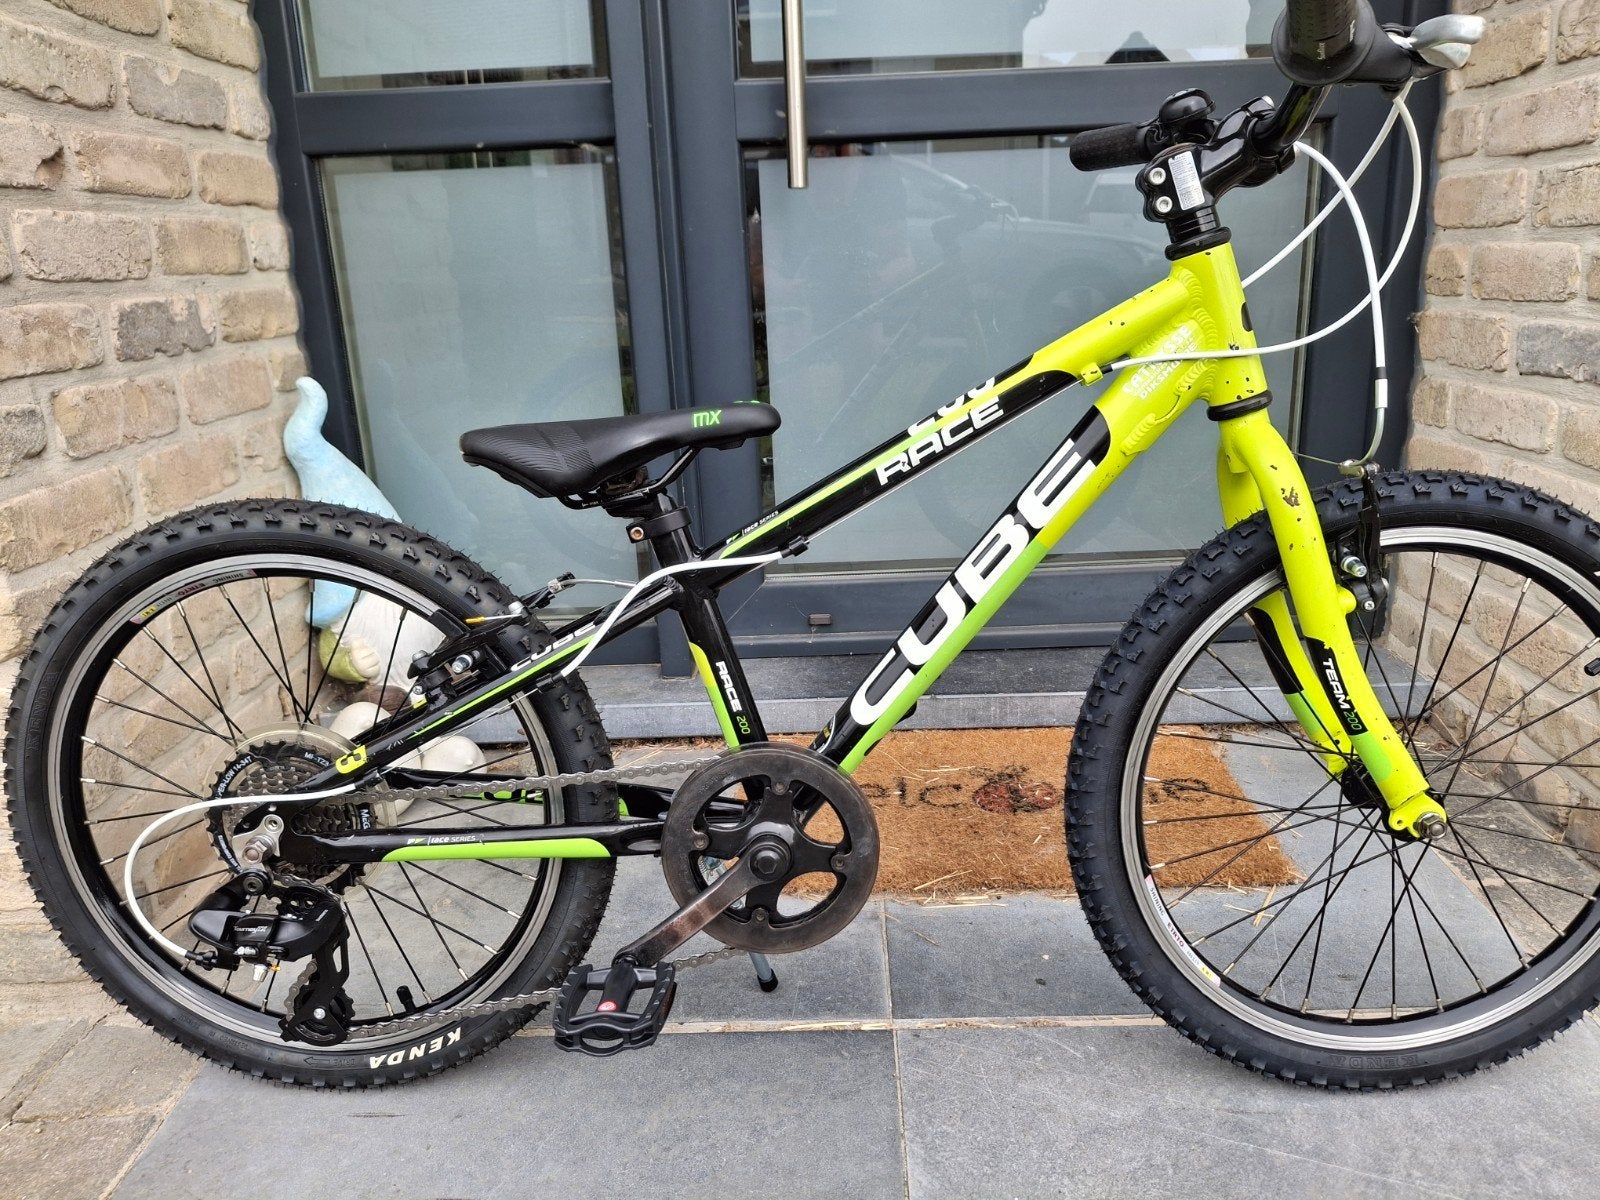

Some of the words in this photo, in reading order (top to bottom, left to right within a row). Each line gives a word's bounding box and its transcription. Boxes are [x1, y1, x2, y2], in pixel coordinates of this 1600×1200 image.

[1140, 343, 1198, 400] DIKSMUE
[875, 395, 1004, 486] RACE
[850, 437, 1098, 726] CUBE
[715, 660, 742, 712] RACE
[736, 715, 751, 735] 200
[1323, 657, 1351, 709] TEAM
[1344, 711, 1362, 730] 200
[370, 1026, 461, 1069] KENDA
[1330, 1055, 1418, 1070] KENDA
